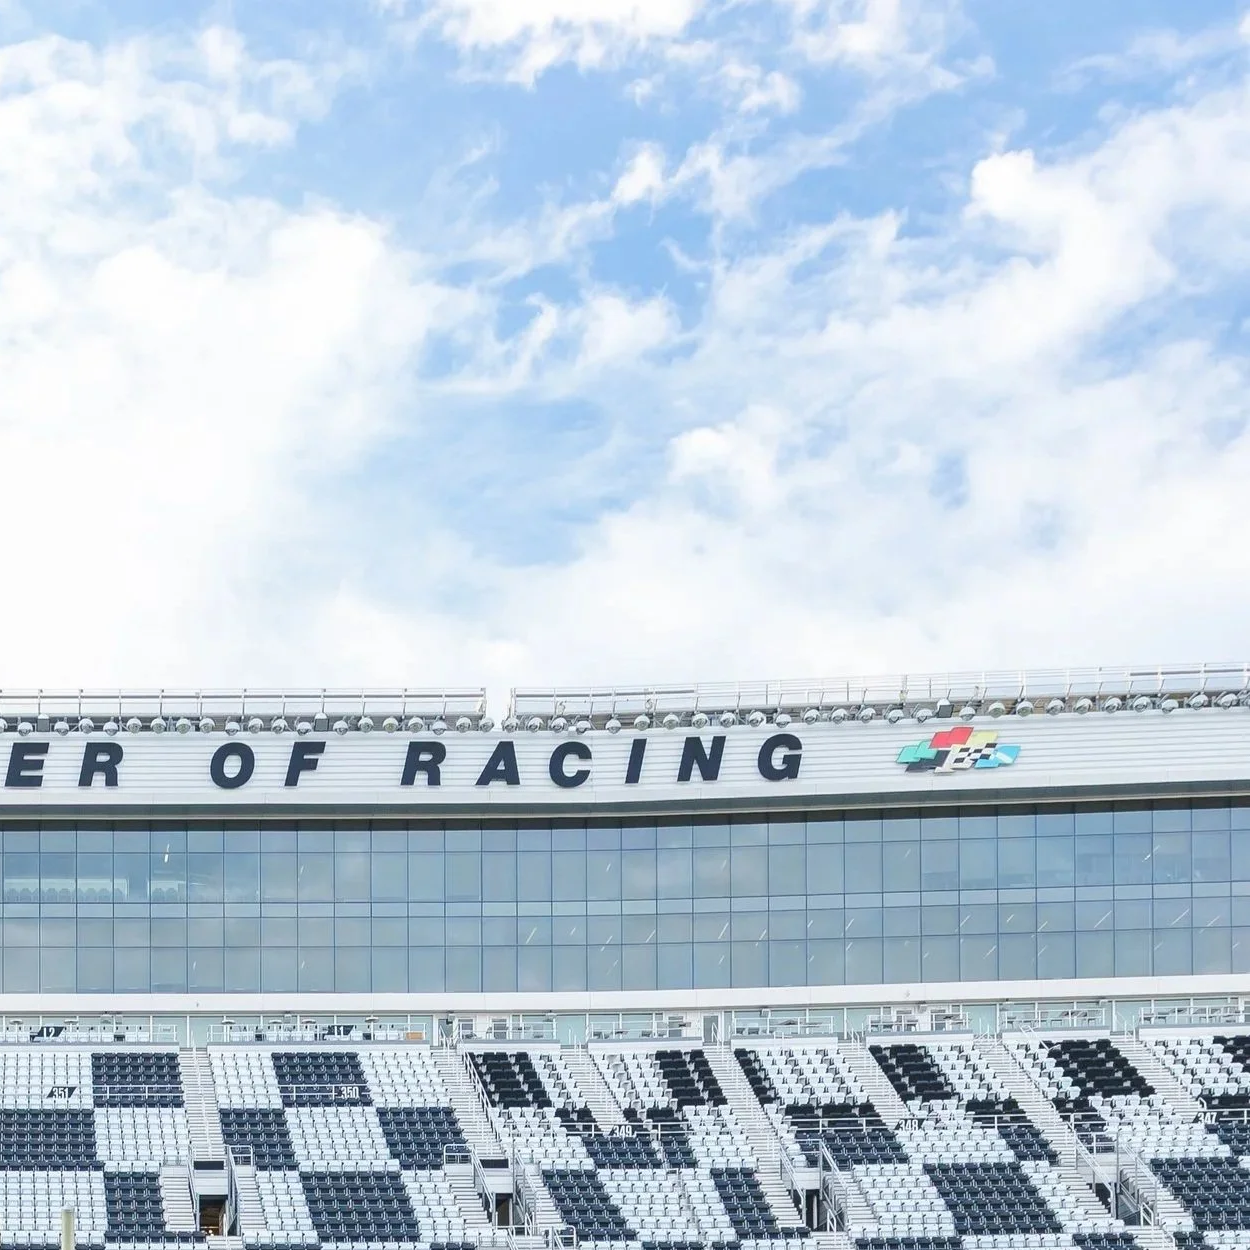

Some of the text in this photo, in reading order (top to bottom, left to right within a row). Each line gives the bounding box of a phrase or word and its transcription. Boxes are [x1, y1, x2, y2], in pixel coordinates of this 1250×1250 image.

[210, 741, 327, 790] OF
[400, 733, 803, 789] RACING
[52, 1087, 69, 1099] 351
[340, 1086, 359, 1098] 350
[1197, 1112, 1217, 1124] 347
[613, 1125, 632, 1137] 349
[899, 1119, 919, 1131] 348
